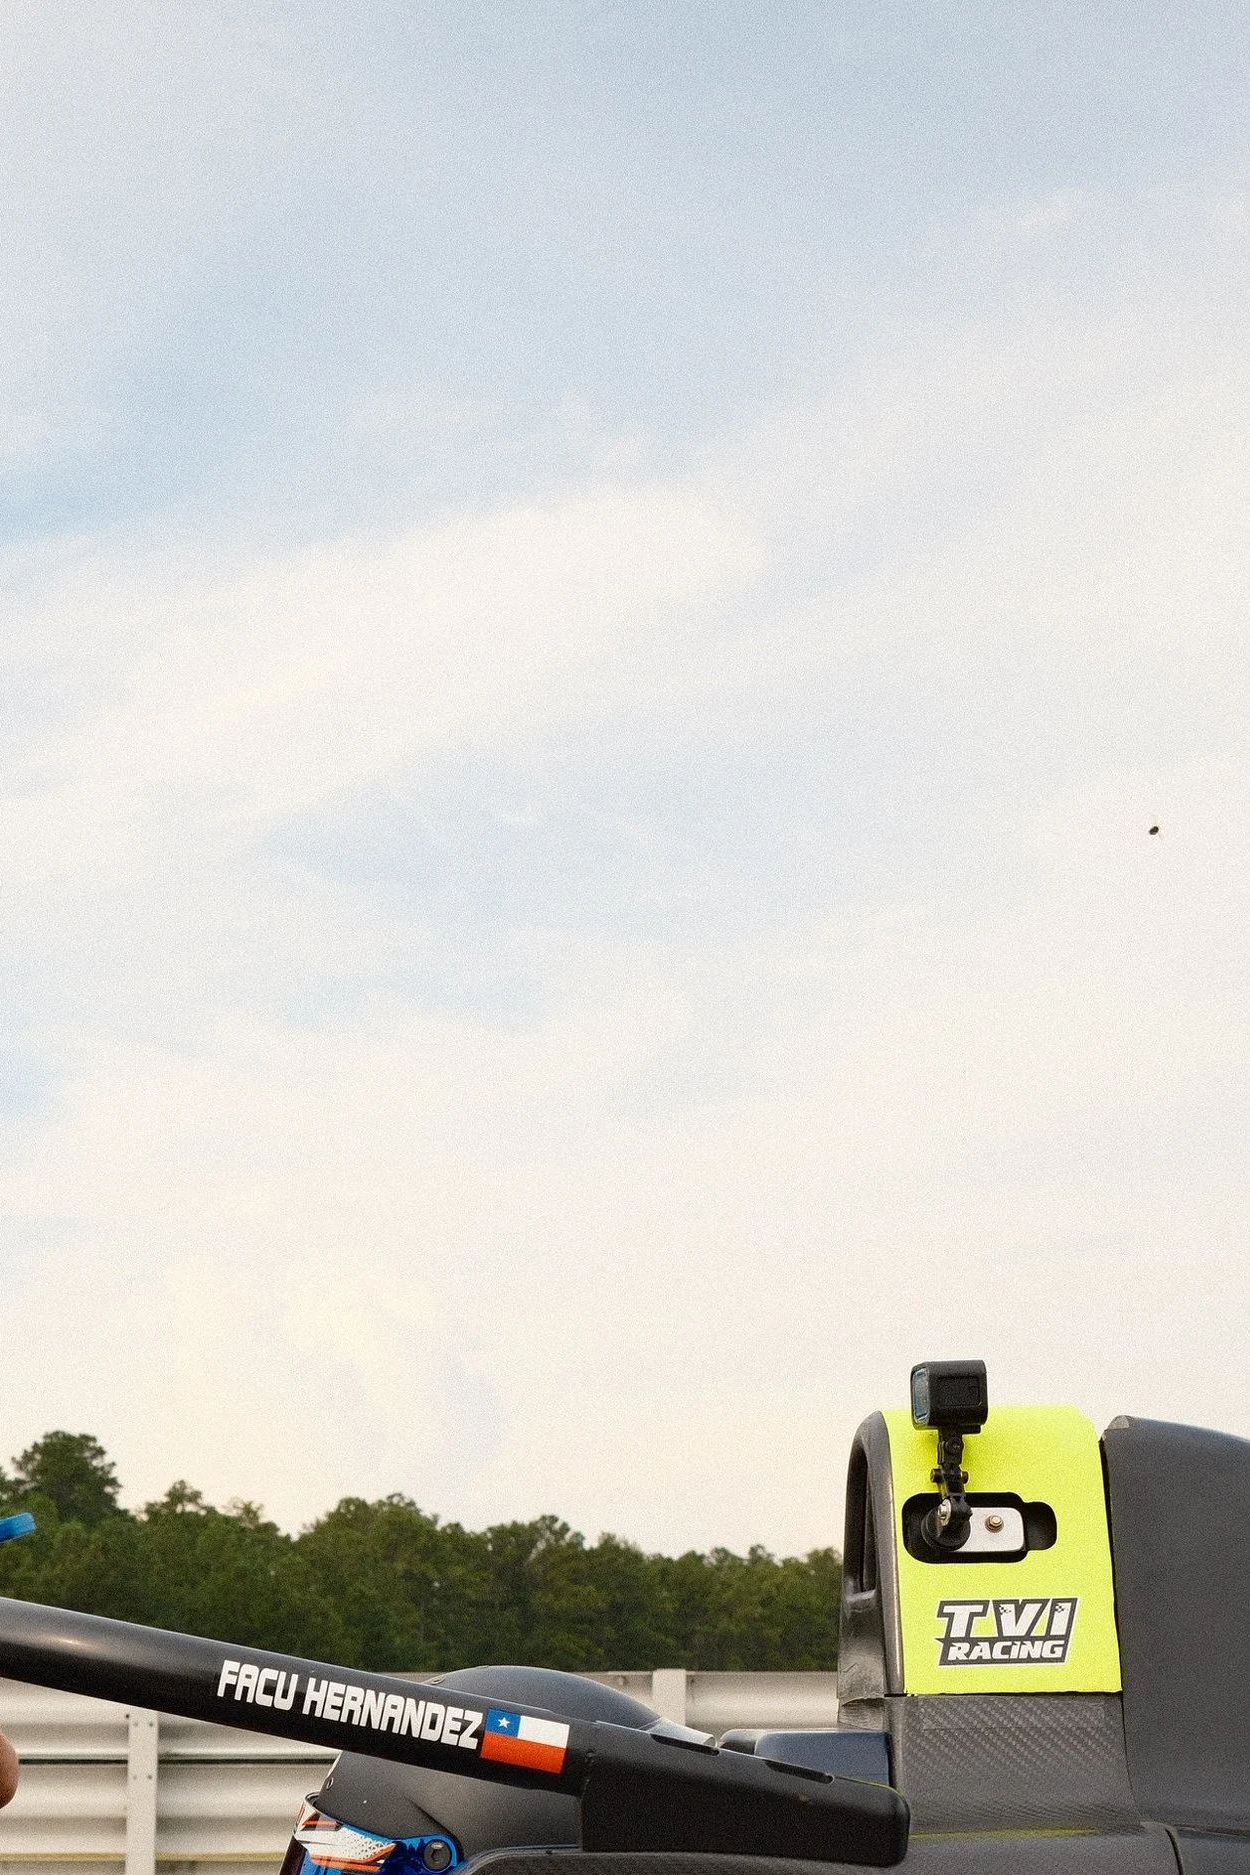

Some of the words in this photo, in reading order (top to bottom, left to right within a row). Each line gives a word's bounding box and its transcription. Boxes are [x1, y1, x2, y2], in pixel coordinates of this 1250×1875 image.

[942, 1602, 1073, 1638] TVI
[947, 1640, 1066, 1661] RACING
[217, 1659, 300, 1711] FACU
[302, 1677, 484, 1750] HERNANDEZ
